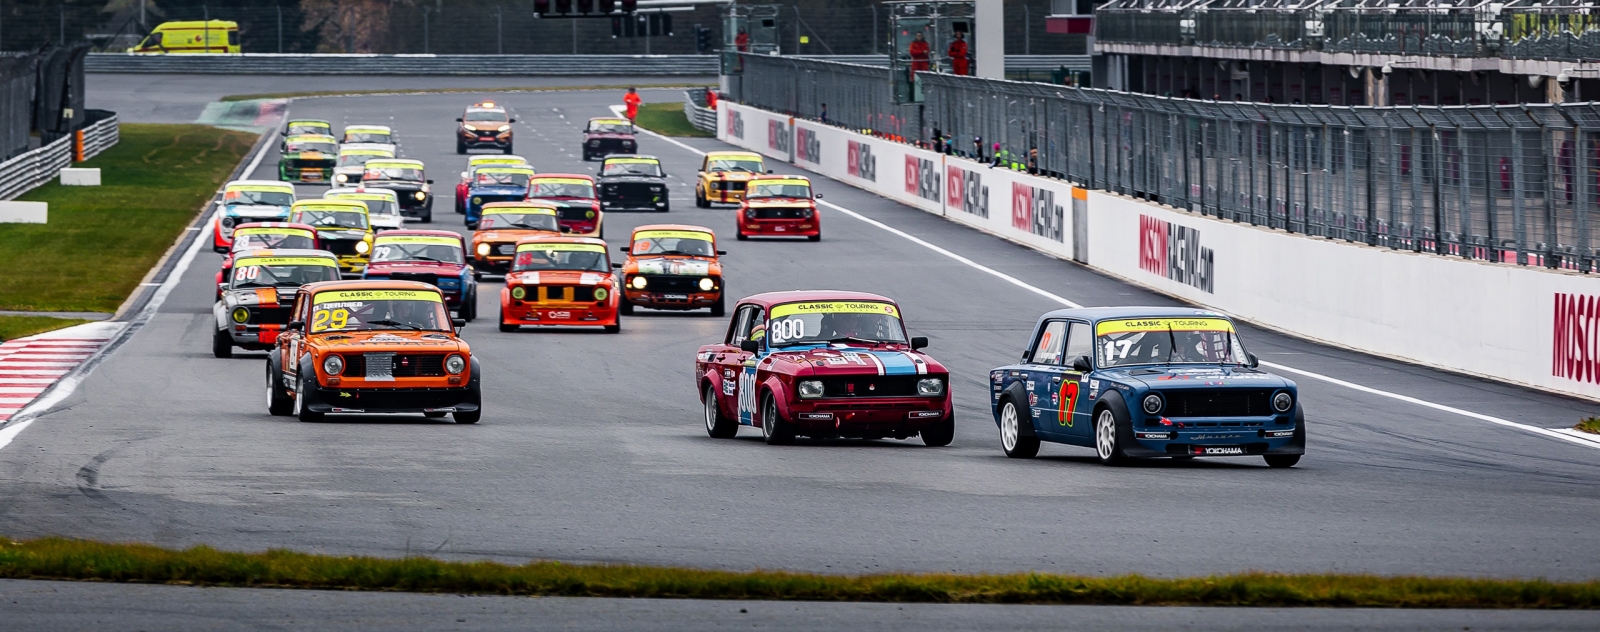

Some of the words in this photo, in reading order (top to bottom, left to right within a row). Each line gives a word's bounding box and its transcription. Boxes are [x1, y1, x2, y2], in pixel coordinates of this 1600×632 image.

[234, 235, 250, 248] 28
[635, 241, 651, 252] 19
[374, 247, 391, 259] 79
[235, 266, 259, 281] 80
[313, 308, 349, 331] 29
[771, 318, 804, 341] 800
[1104, 340, 1132, 361] 17
[1059, 379, 1080, 427] 17
